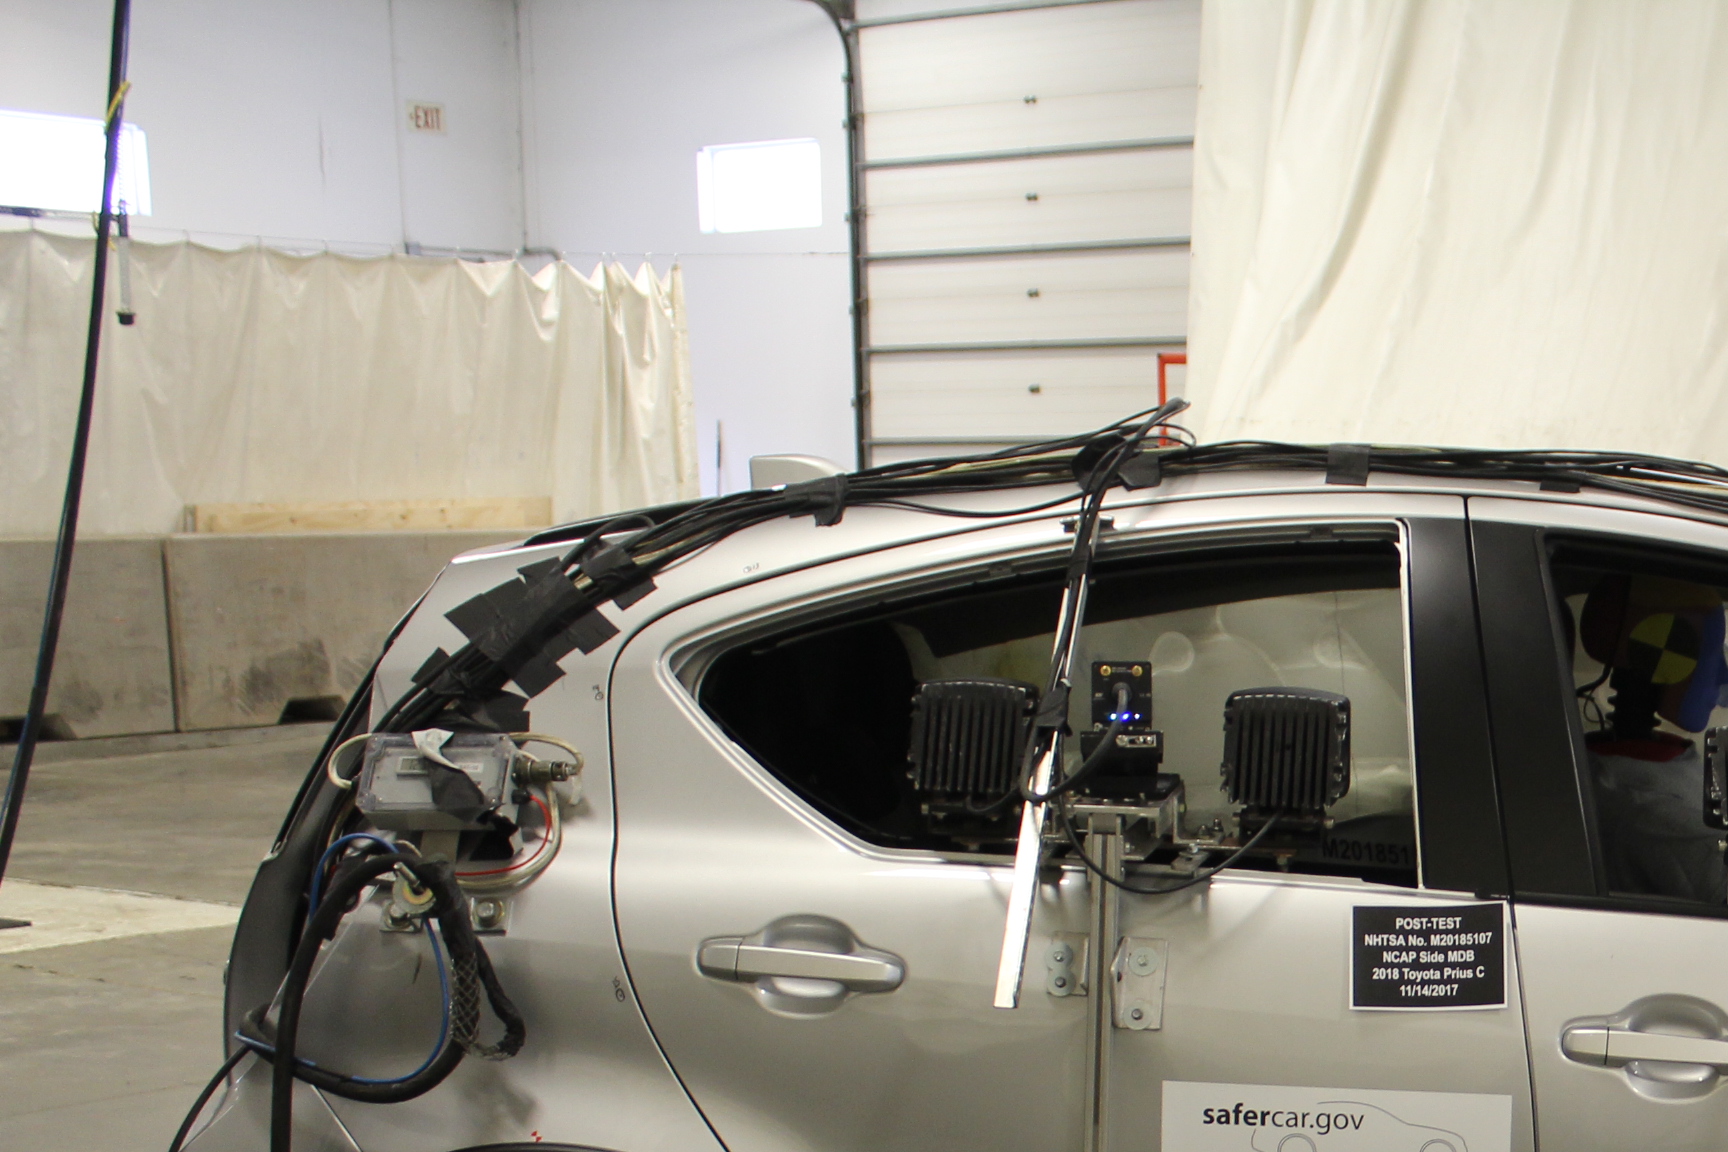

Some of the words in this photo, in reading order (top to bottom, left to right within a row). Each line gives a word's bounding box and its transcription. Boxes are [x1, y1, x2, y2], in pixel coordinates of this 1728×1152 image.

[414, 105, 441, 131] EXIT
[1396, 917, 1461, 929] POST-TEST
[1365, 934, 1405, 946] NHTSA
[1408, 935, 1427, 946] No.
[1431, 932, 1492, 946] M20185107
[1383, 951, 1416, 963] NCAP
[1420, 951, 1444, 963] Side
[1448, 950, 1474, 962] MDB
[1373, 968, 1399, 979] 2018
[1402, 968, 1440, 982] Toyota
[1444, 967, 1473, 979] Prius
[1476, 966, 1484, 977] C
[1400, 984, 1458, 996] 11/14/2017
[1203, 1103, 1364, 1134] safercar.gov
